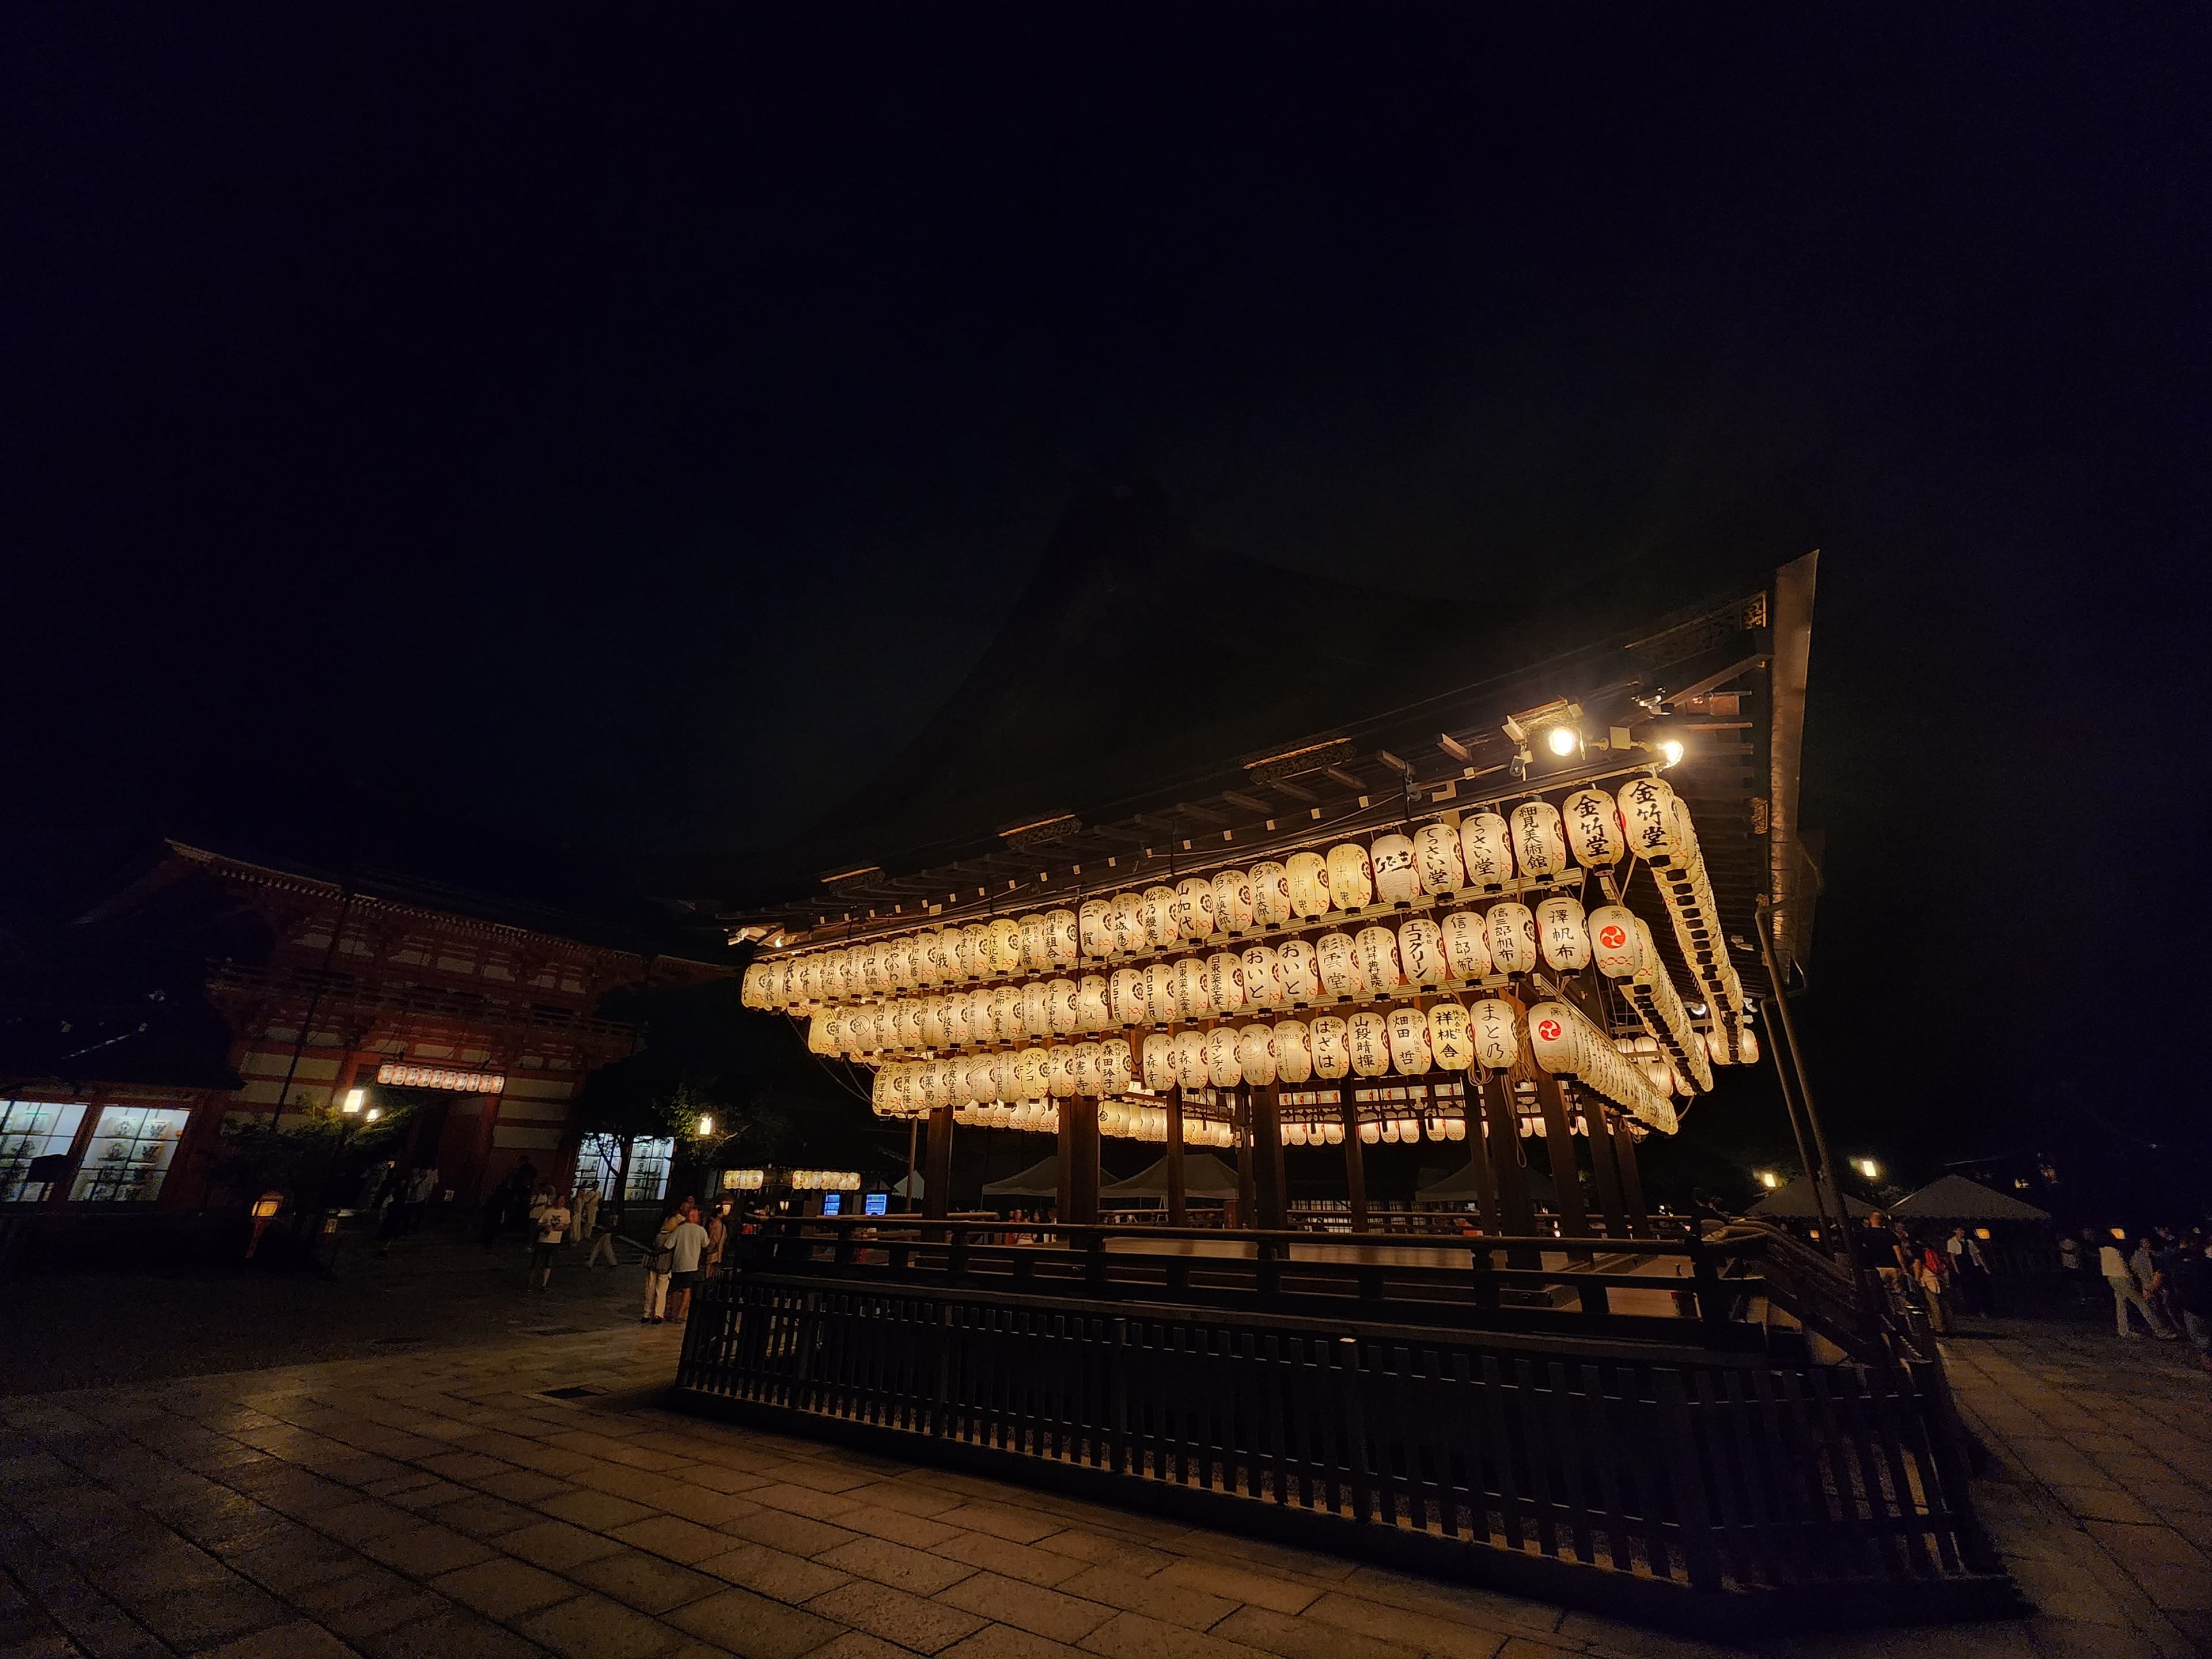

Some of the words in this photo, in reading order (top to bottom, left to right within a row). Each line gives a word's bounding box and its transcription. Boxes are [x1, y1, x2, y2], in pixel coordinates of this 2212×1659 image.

[1518, 806, 1549, 869] 細見美術館
[1573, 794, 1610, 858] 金竹堂
[1628, 781, 1668, 849] 金竹堂
[1422, 827, 1448, 886] てっさい堂
[1469, 816, 1496, 876] てっさい堂
[1177, 882, 1194, 931] 山加代
[1046, 912, 1060, 959] 用達組合
[1405, 923, 1429, 979] エコグリーン
[1491, 907, 1514, 962] 信三郎帆布
[890, 941, 900, 982] はやかわ
[1179, 961, 1192, 1013] 日東薬品工業
[1210, 956, 1225, 1007] 日東薬品工業
[1247, 950, 1264, 999] おいと
[1282, 944, 1301, 995] おいと
[1320, 938, 1347, 990] 彩雲堂
[1113, 972, 1122, 1020] NOSTER
[1146, 967, 1156, 1017] NOSTER
[1024, 1052, 1035, 1081] パチンコ
[1052, 1048, 1060, 1074] サウナ
[1103, 1044, 1116, 1089] 森田玲子
